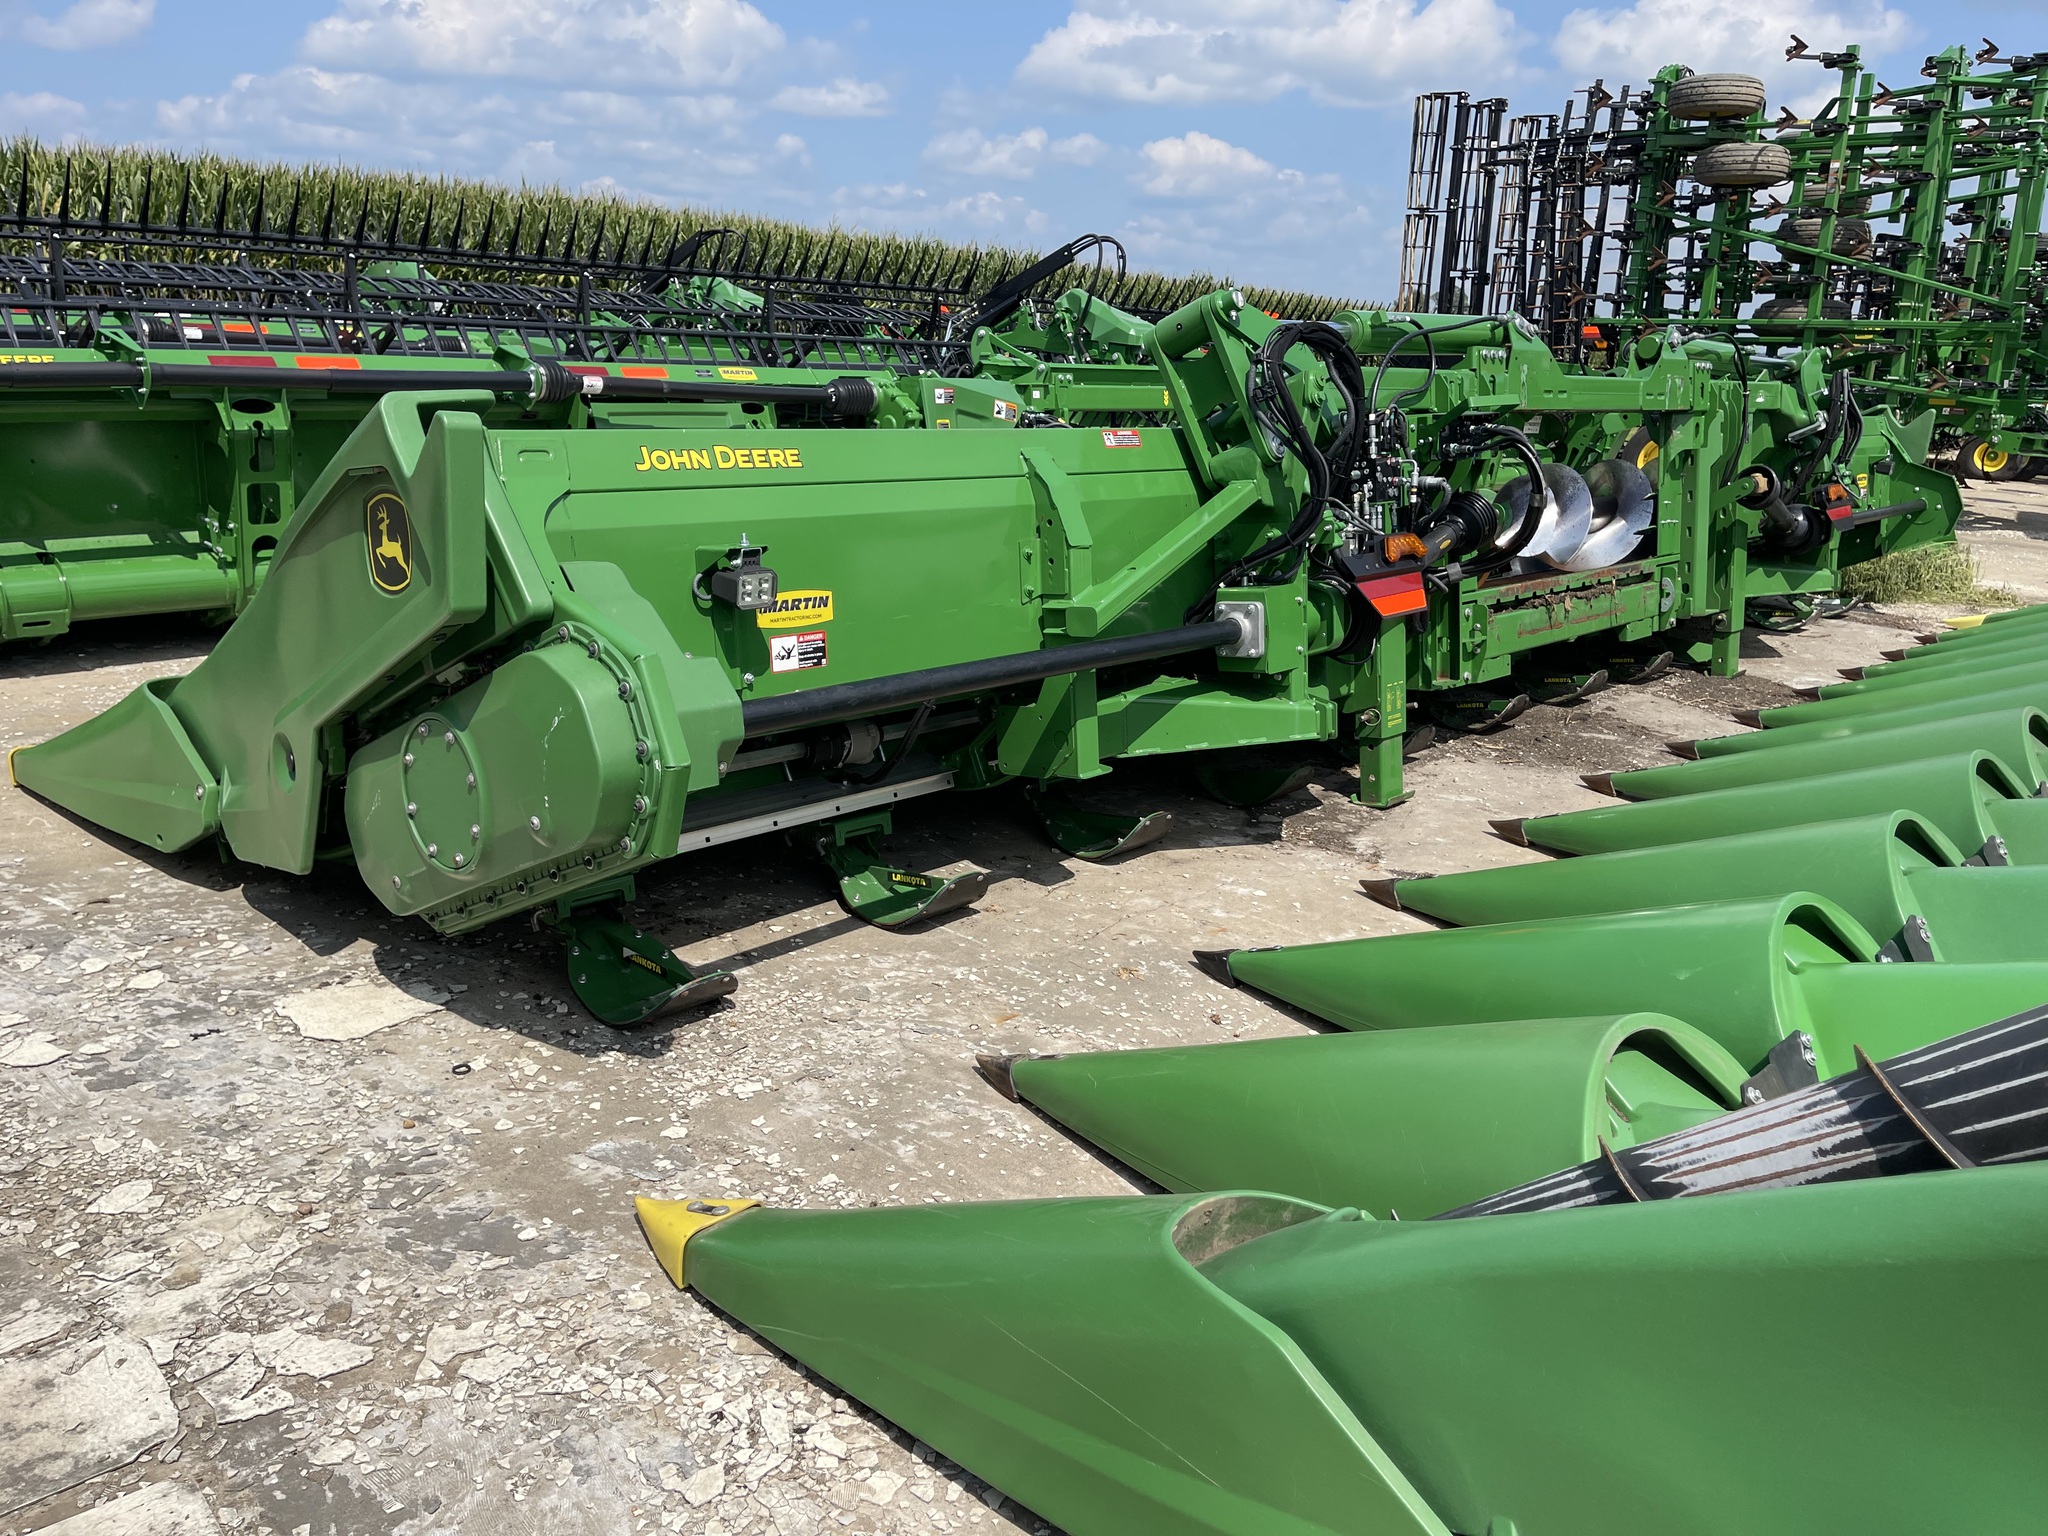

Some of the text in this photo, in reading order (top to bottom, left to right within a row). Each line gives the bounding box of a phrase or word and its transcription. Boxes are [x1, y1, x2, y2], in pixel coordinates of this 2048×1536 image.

[0, 355, 55, 364] EERE
[635, 445, 803, 471] JOHN DEERE
[760, 595, 829, 614] MARTIN
[769, 614, 823, 624] MARTINTRACTORINC.COM
[891, 872, 926, 886] LANKOTA
[630, 954, 662, 974] ANKOTA
